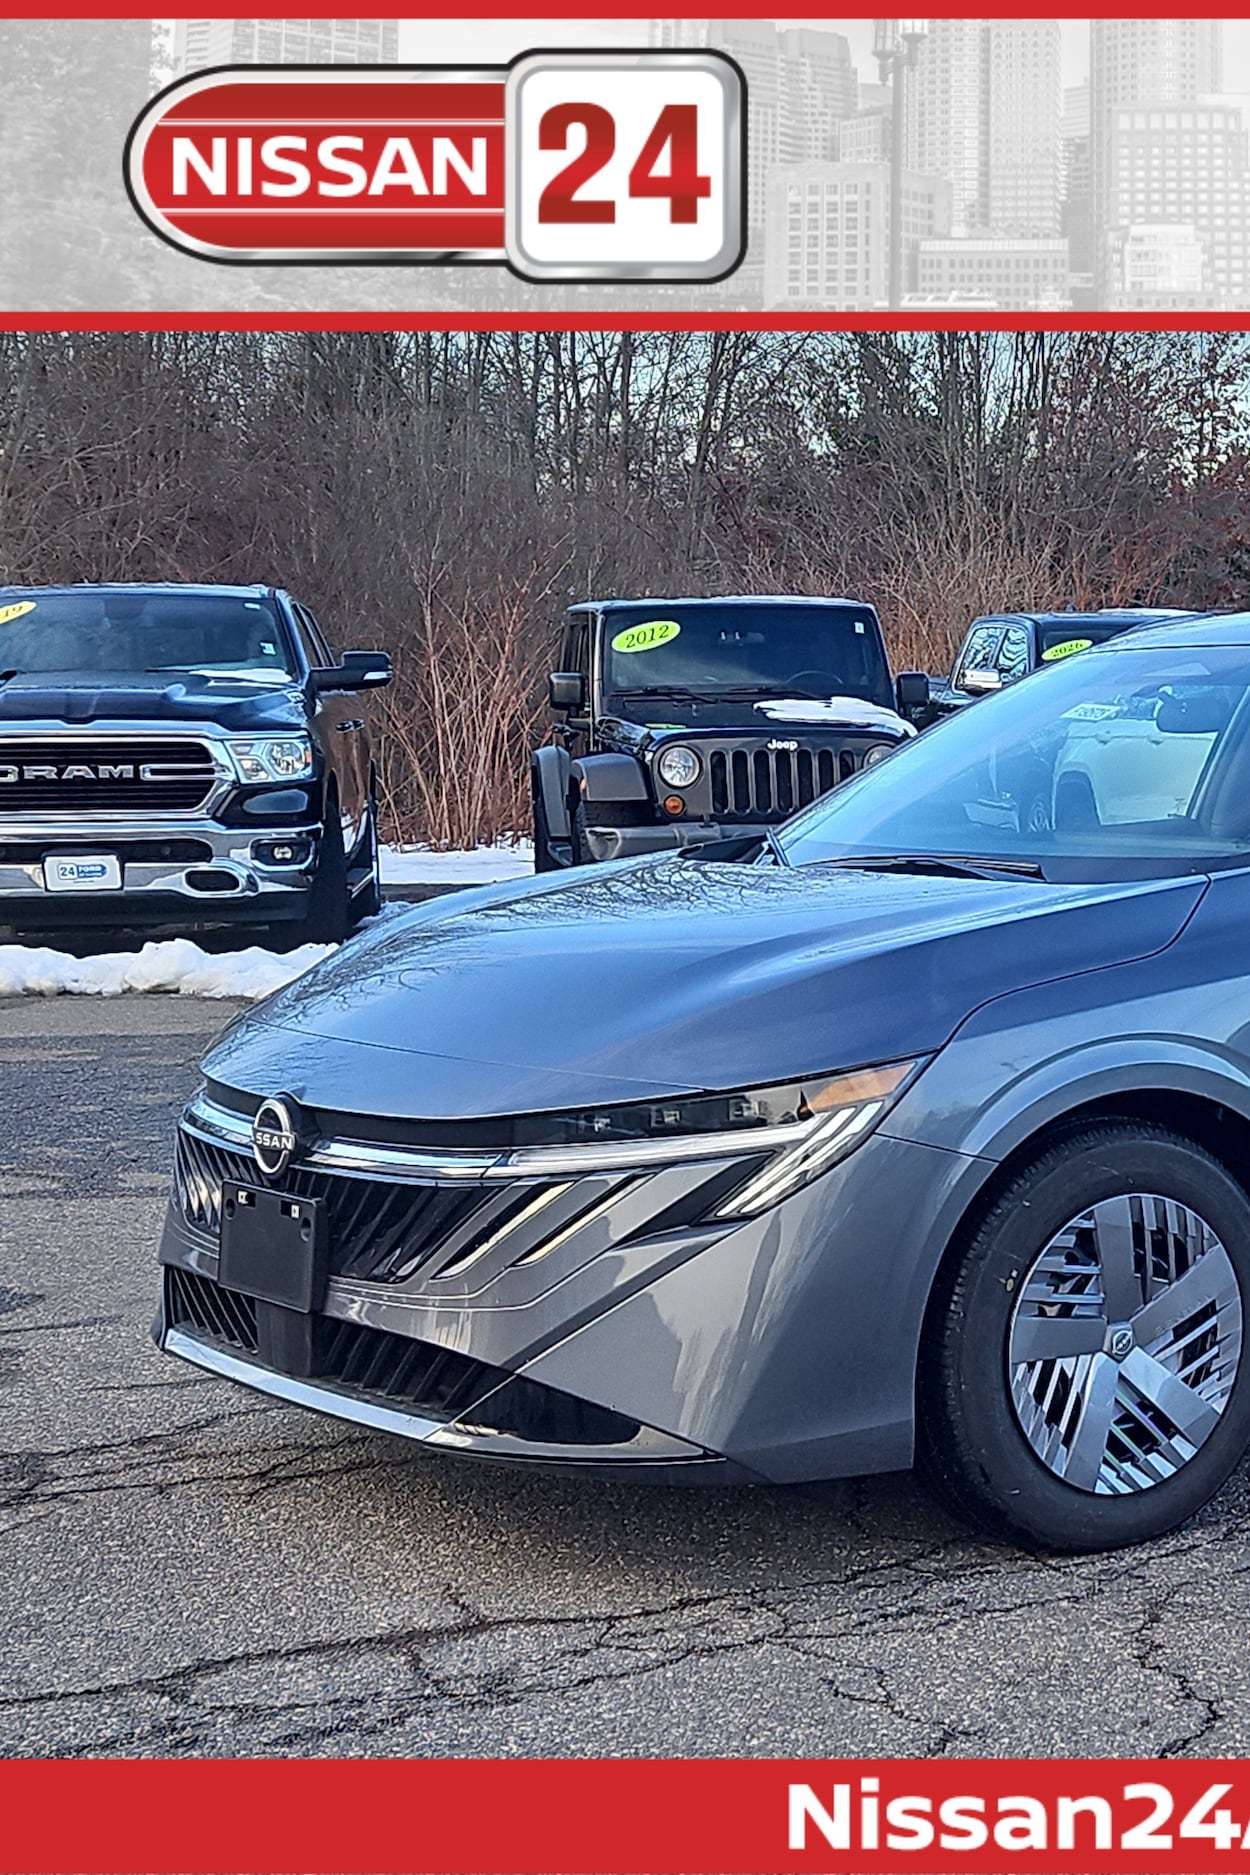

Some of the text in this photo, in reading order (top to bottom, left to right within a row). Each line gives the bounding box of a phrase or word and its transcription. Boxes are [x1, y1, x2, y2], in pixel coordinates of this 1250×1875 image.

[626, 624, 669, 648] 2012
[767, 738, 799, 751] Jeep
[22, 764, 134, 780] RAM
[59, 866, 76, 877] 24
[255, 1132, 292, 1150] SSAN
